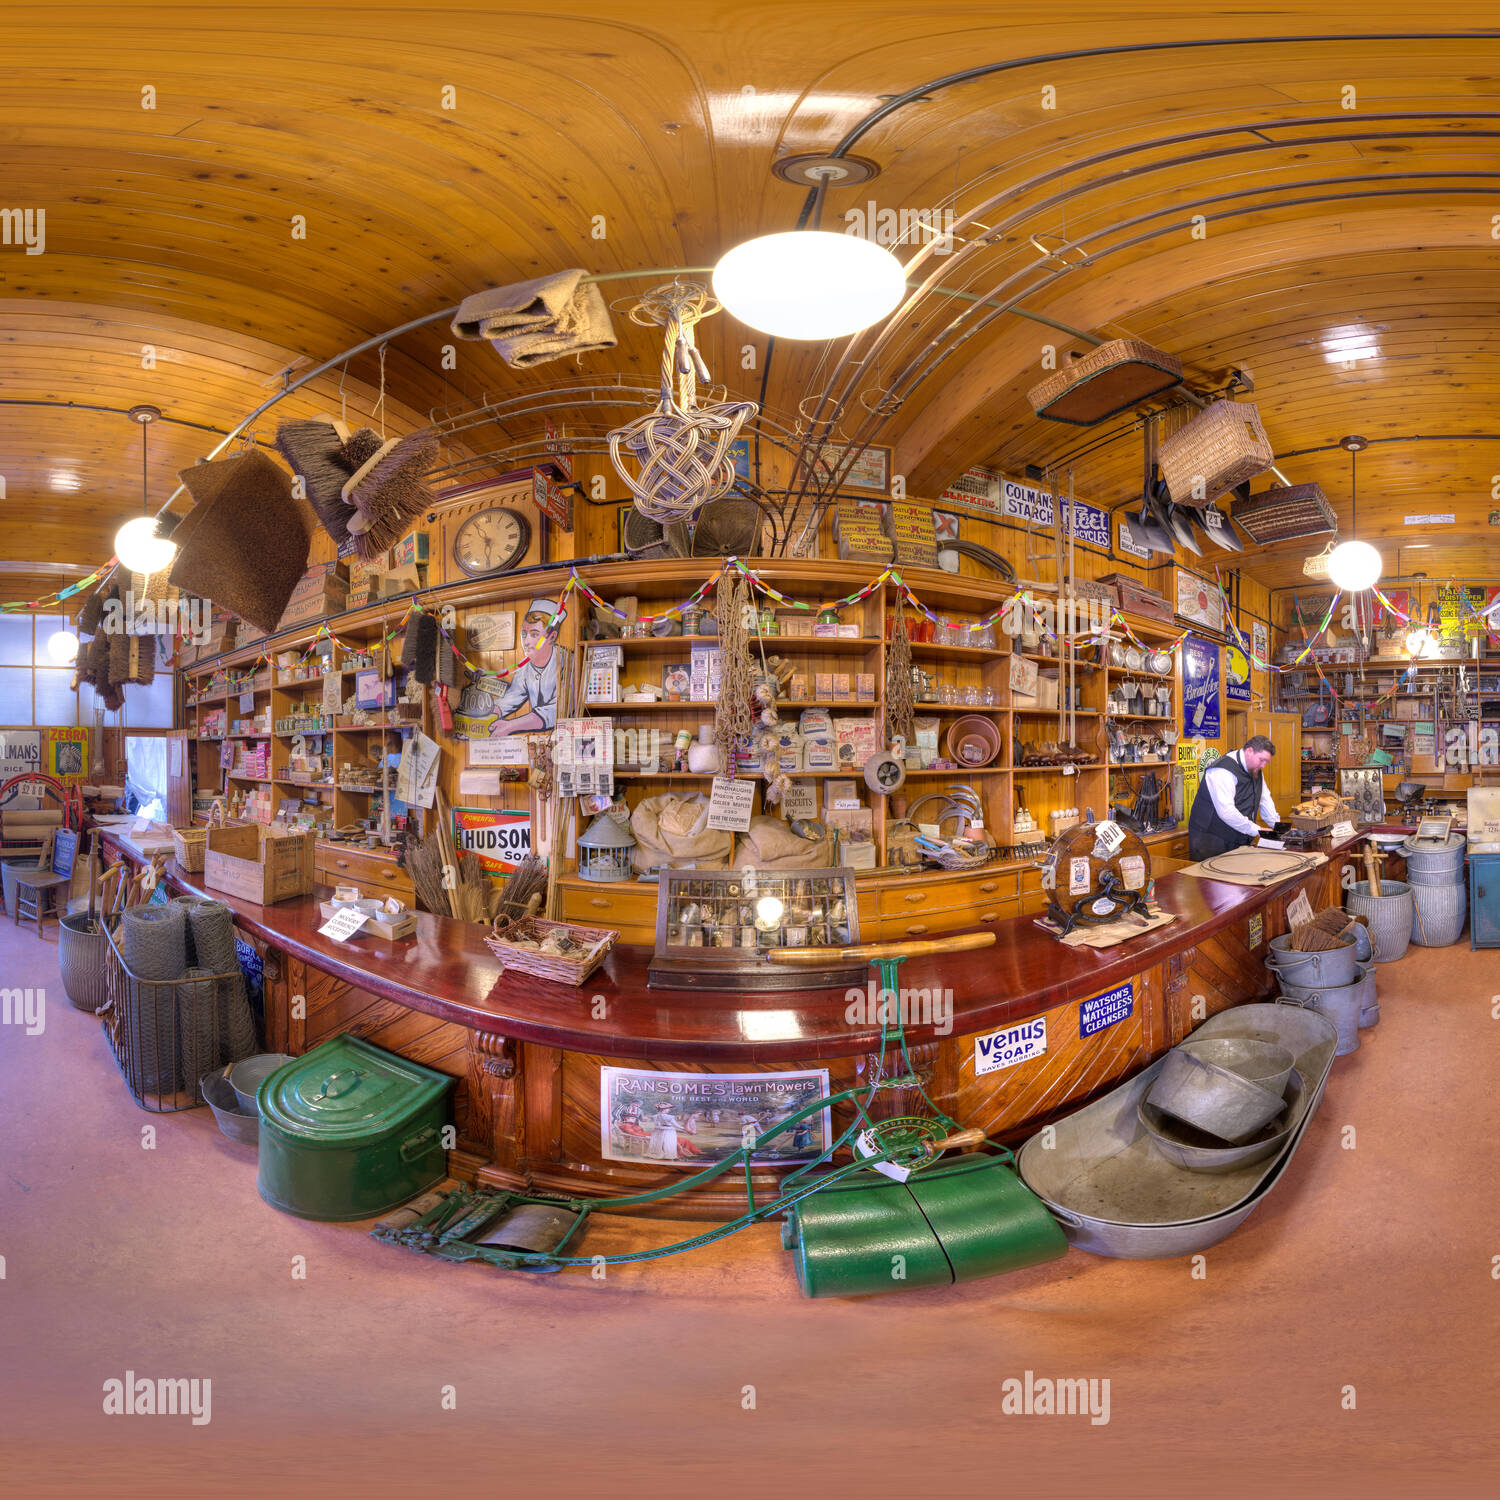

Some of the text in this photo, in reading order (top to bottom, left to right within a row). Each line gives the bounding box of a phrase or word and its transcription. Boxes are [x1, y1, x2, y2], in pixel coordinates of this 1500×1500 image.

[1006, 484, 1054, 510] COLMAN'S
[1008, 500, 1053, 523] STARCH
[1189, 648, 1204, 657] BEST
[1229, 686, 1251, 698] MACHINES
[50, 728, 88, 741] ZEBRA
[0, 745, 38, 760] LMAN'S
[792, 788, 805, 797] DOG
[785, 798, 813, 807] BISCUITS
[464, 814, 496, 823] POWERFUL
[485, 860, 503, 870] SAFE
[1084, 987, 1129, 1013] WATSON'S
[1082, 995, 1133, 1025] MATCHLESS
[1085, 1007, 1128, 1034] CLEANSER
[981, 1050, 1041, 1073] SAVES RUBBING
[992, 1043, 1034, 1064] SOAP
[615, 1076, 728, 1096] RANSOMES'
